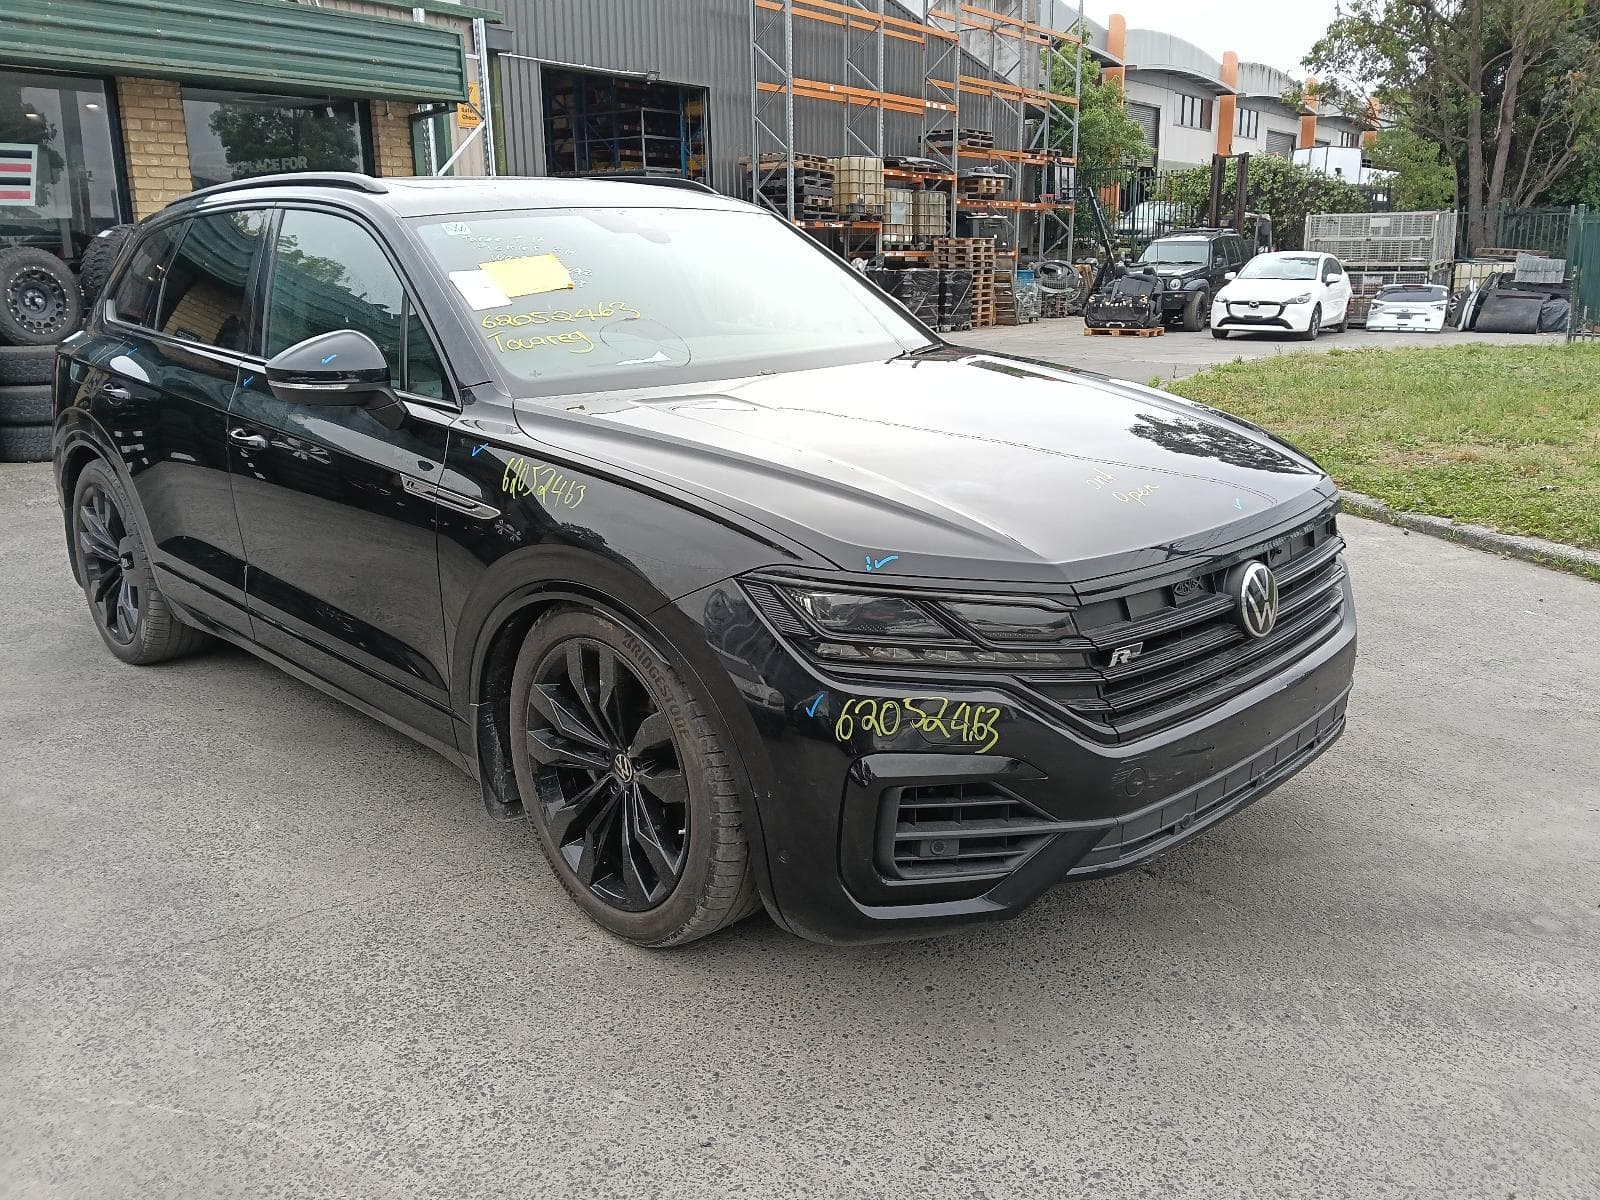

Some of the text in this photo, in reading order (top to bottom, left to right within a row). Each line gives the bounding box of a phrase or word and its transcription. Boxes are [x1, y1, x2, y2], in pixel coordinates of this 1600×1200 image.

[281, 155, 308, 170] FOR
[481, 301, 641, 330] 62052463
[487, 329, 595, 354] Touareg
[502, 458, 587, 509] 62052463
[835, 696, 1001, 754] 62052463
